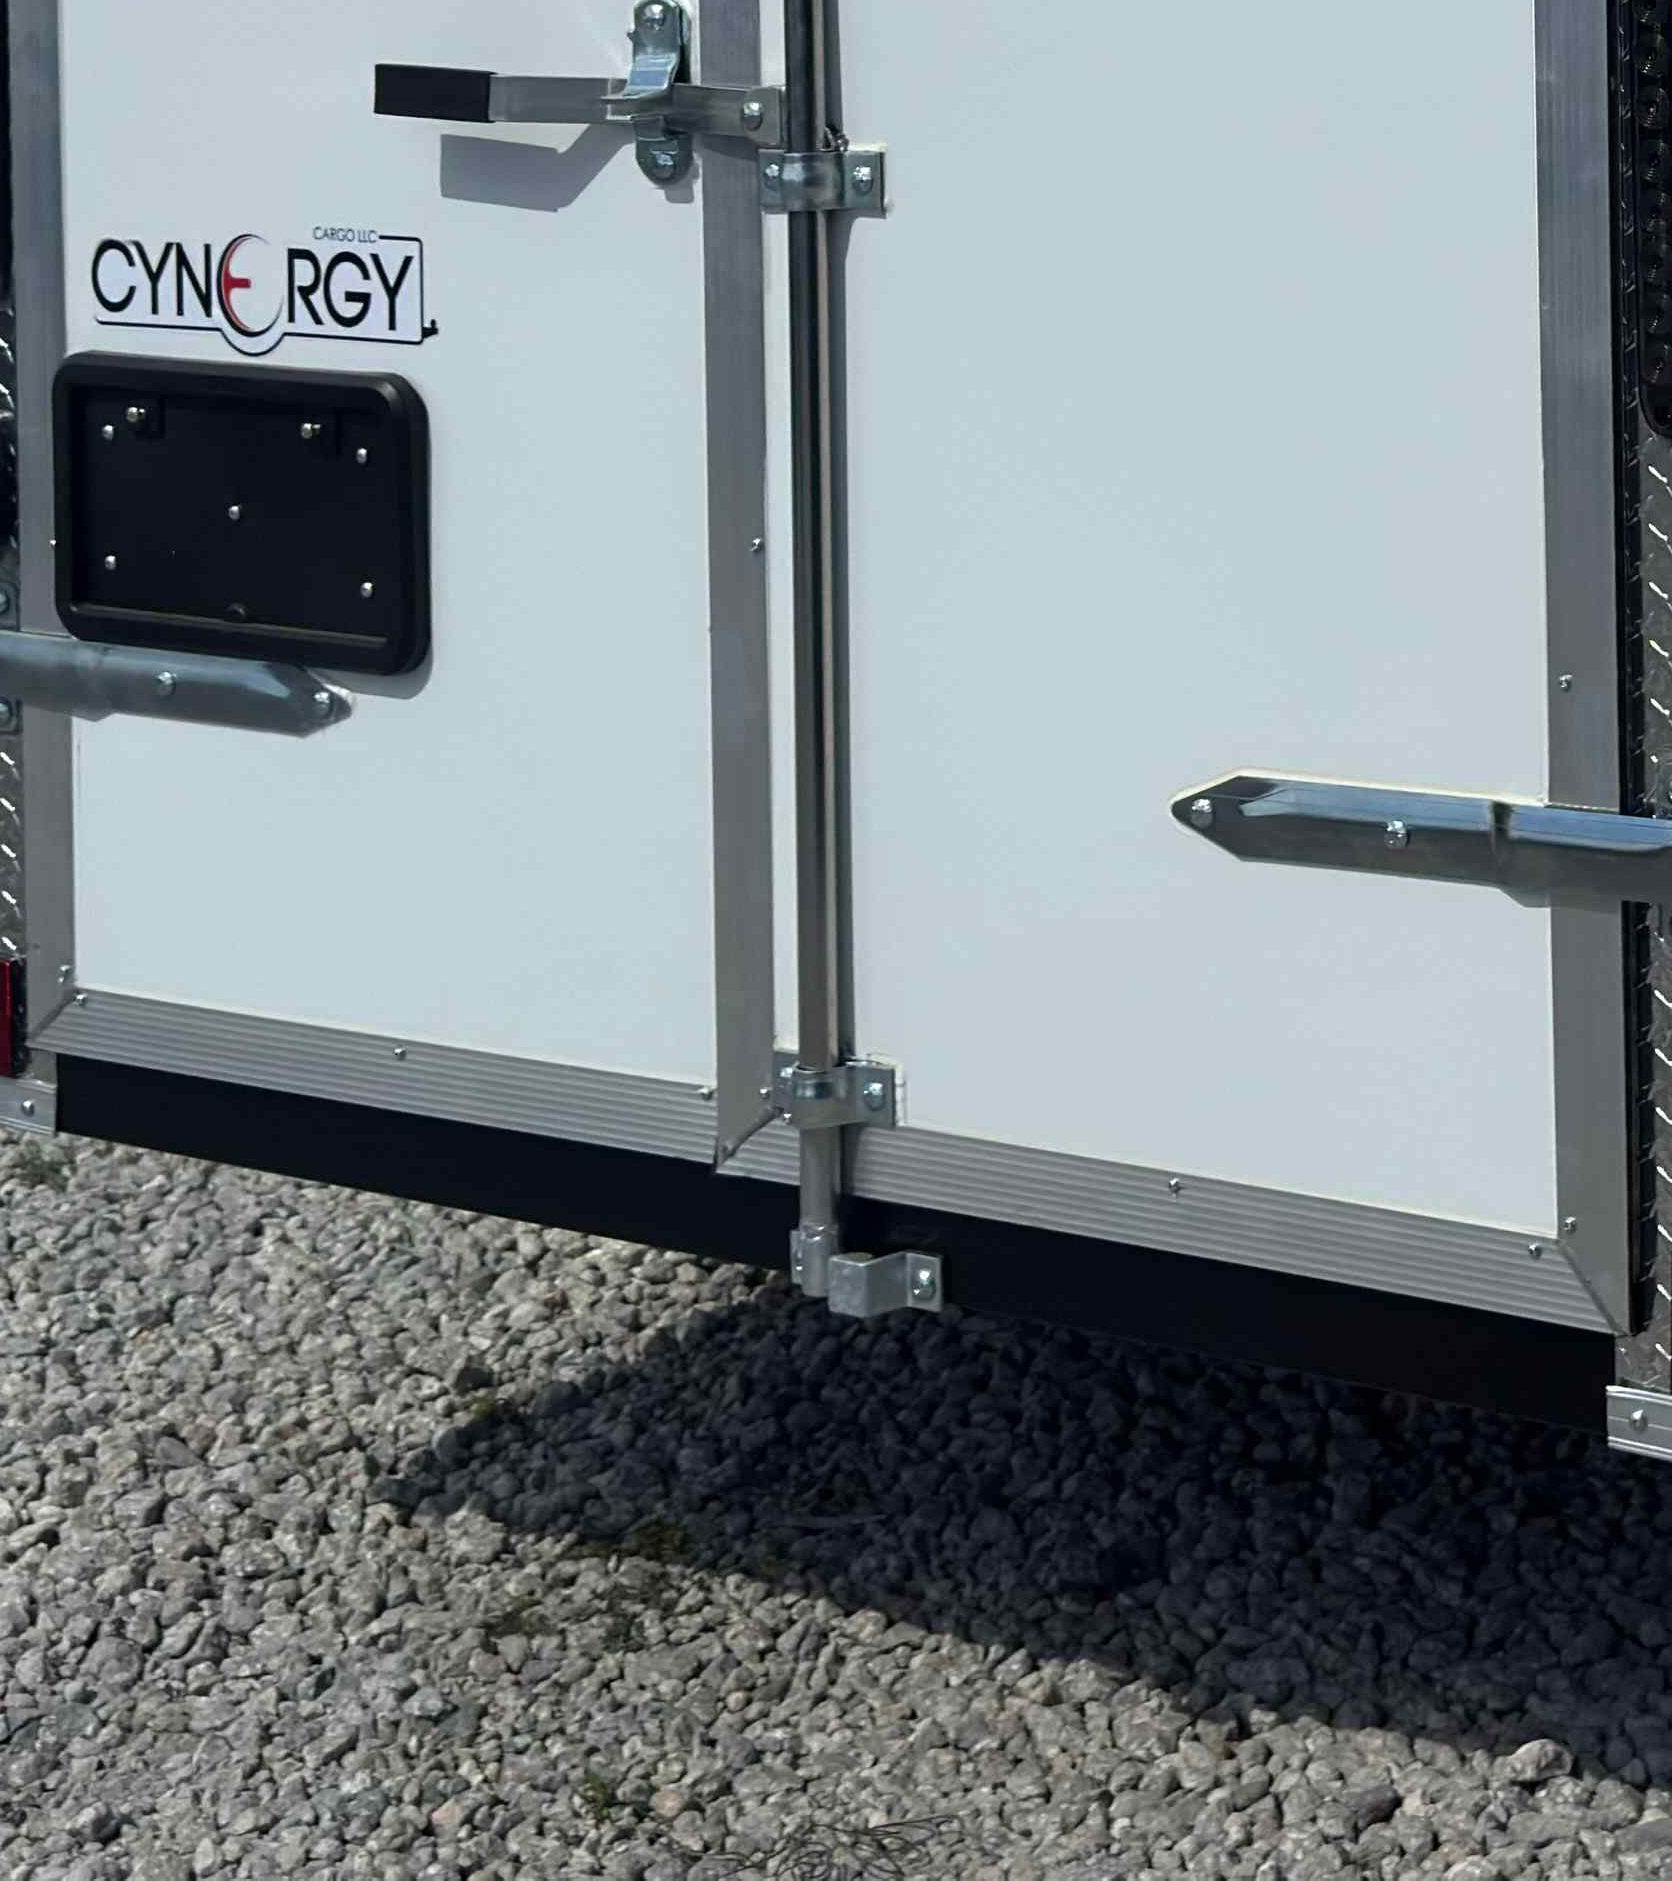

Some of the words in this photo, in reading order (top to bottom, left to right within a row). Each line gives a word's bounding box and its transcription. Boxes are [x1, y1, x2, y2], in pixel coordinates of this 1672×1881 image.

[312, 225, 356, 243] CARGO
[357, 229, 378, 244] LLC
[90, 232, 416, 338] CYNERGY
